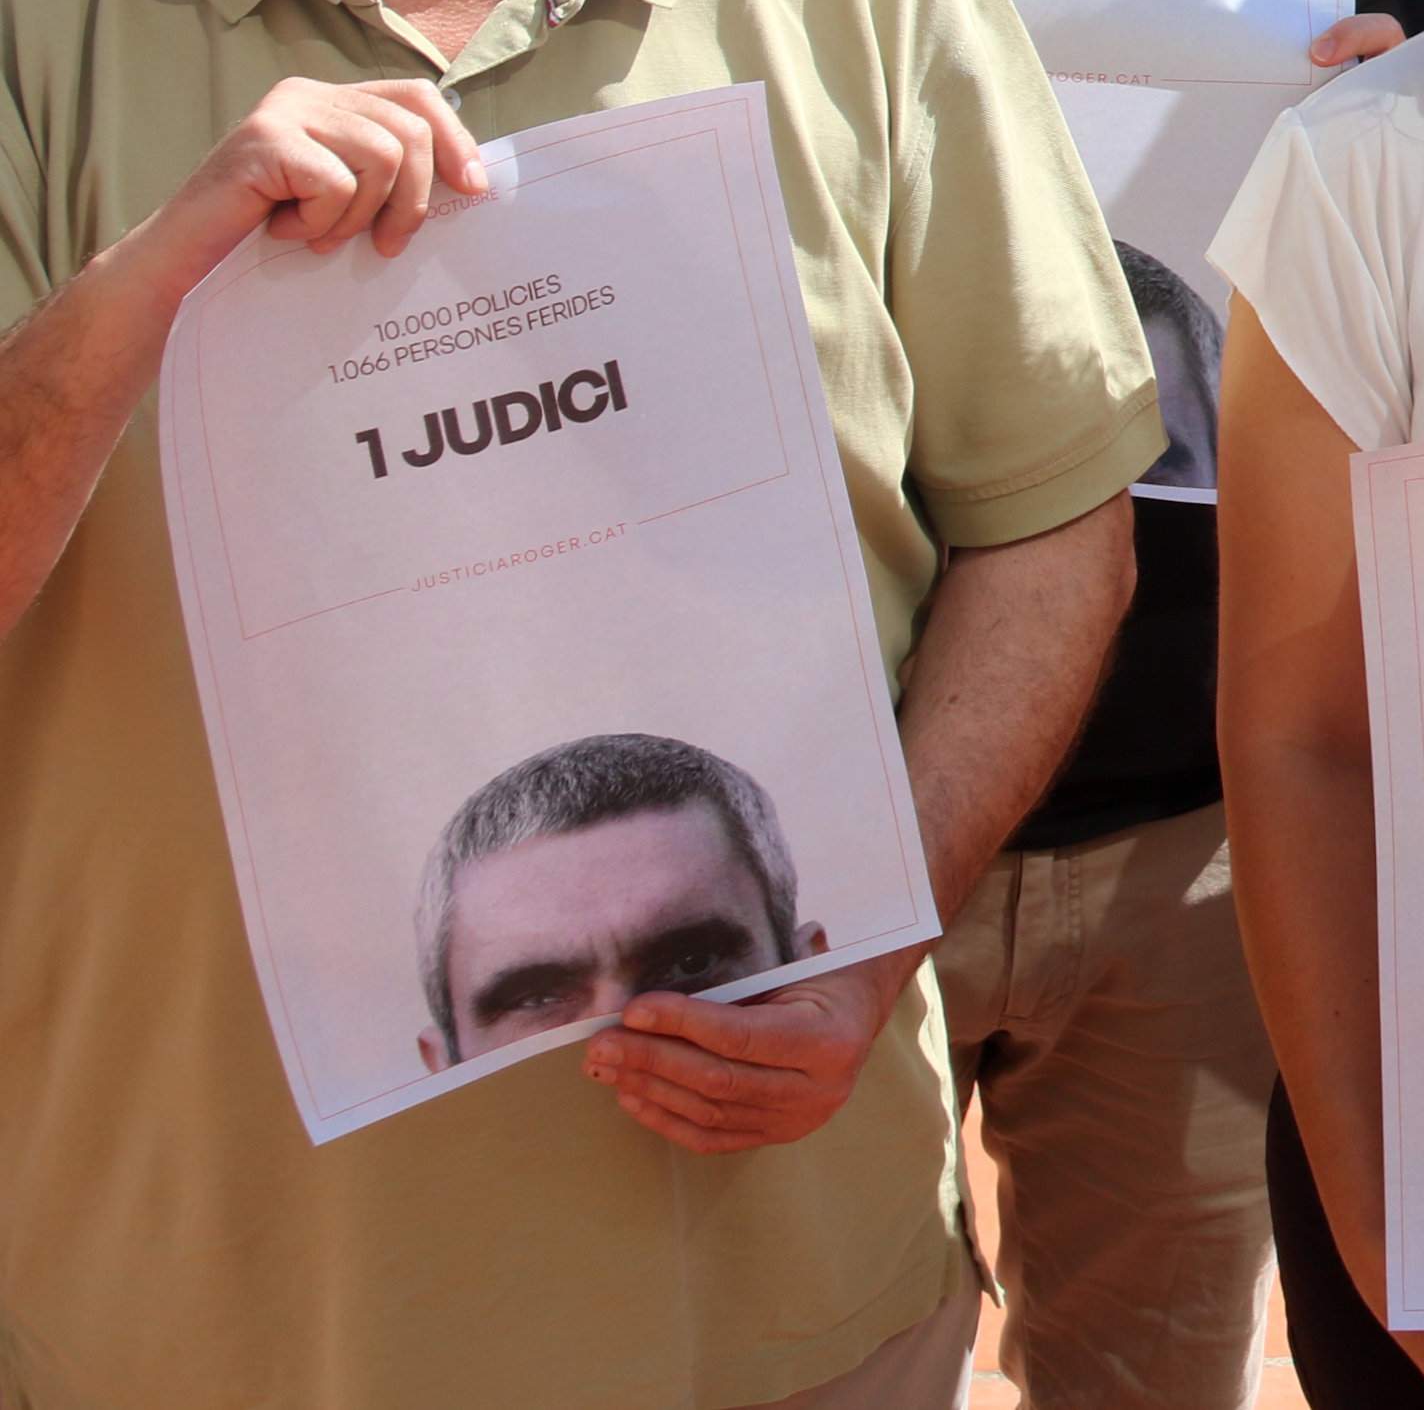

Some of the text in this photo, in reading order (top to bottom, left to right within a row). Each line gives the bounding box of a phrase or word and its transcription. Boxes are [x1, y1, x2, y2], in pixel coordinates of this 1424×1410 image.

[328, 286, 615, 383] 1.066 PERSONES FERIDES
[374, 274, 561, 342] 10.000 POLICIES
[355, 360, 627, 478] 1 JUDICI
[411, 523, 626, 592] JUSTICIAROGER.CAT
